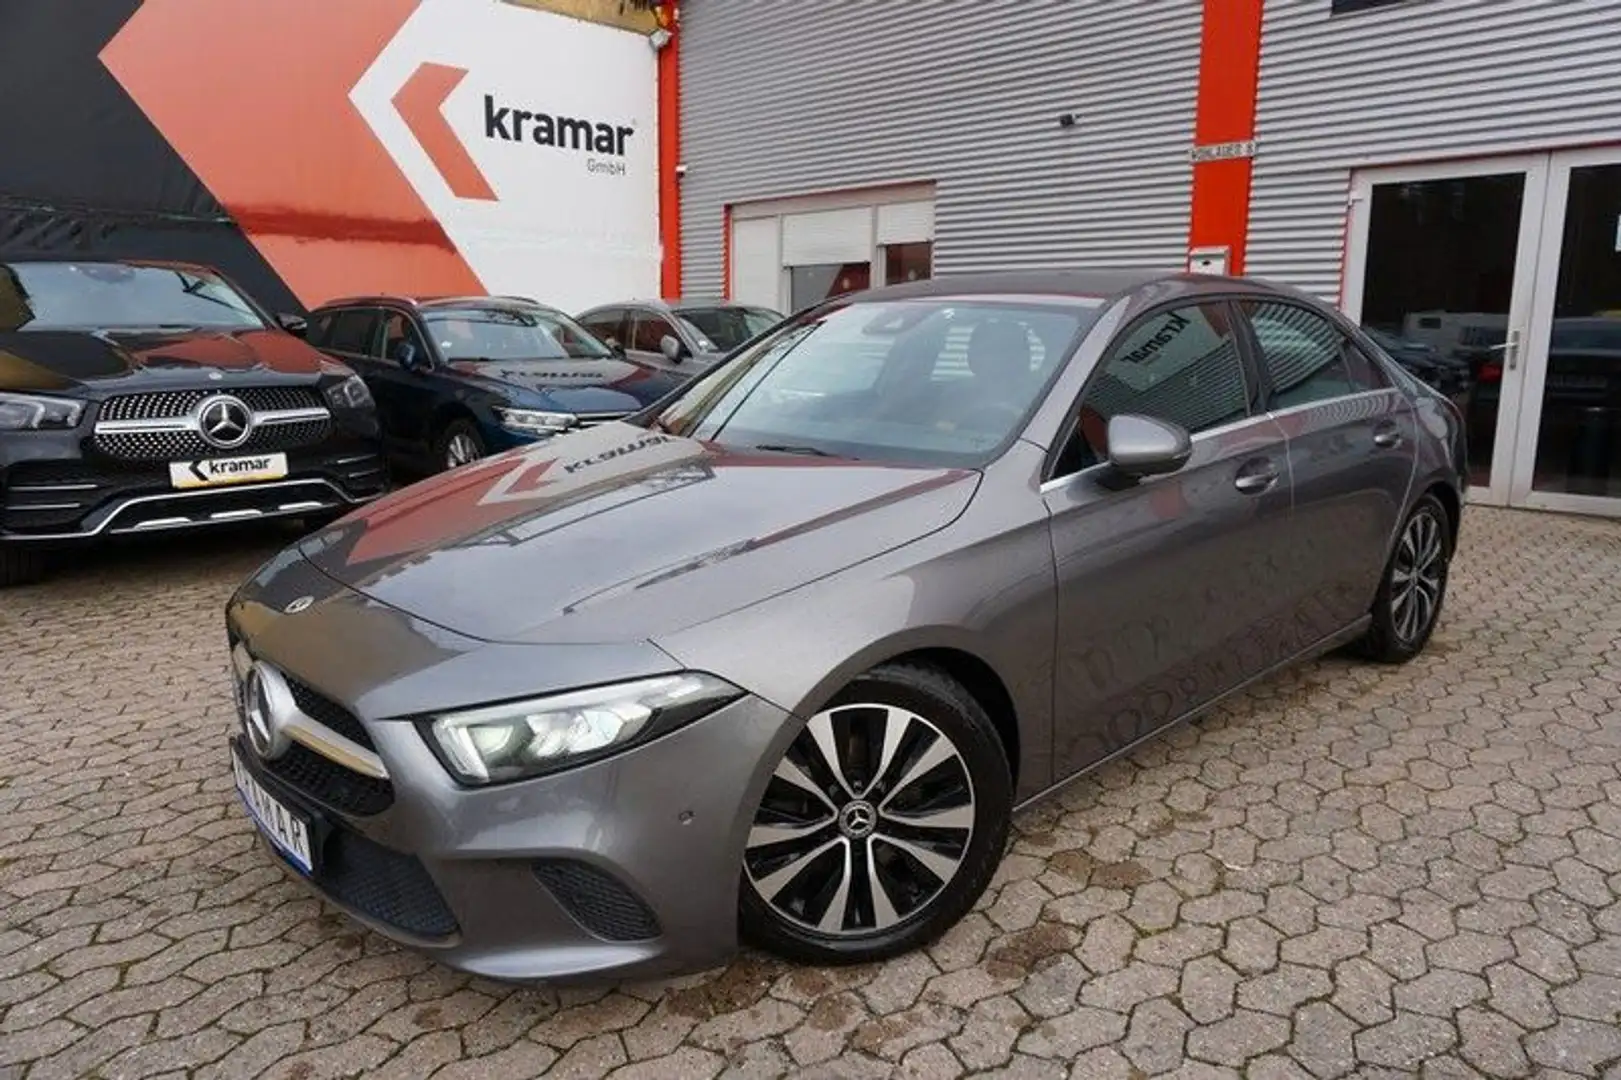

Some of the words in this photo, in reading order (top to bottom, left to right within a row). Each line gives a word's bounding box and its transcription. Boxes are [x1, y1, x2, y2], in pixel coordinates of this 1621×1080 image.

[485, 94, 634, 156] kramar
[586, 158, 626, 175] GmbH
[208, 458, 272, 475] kramar
